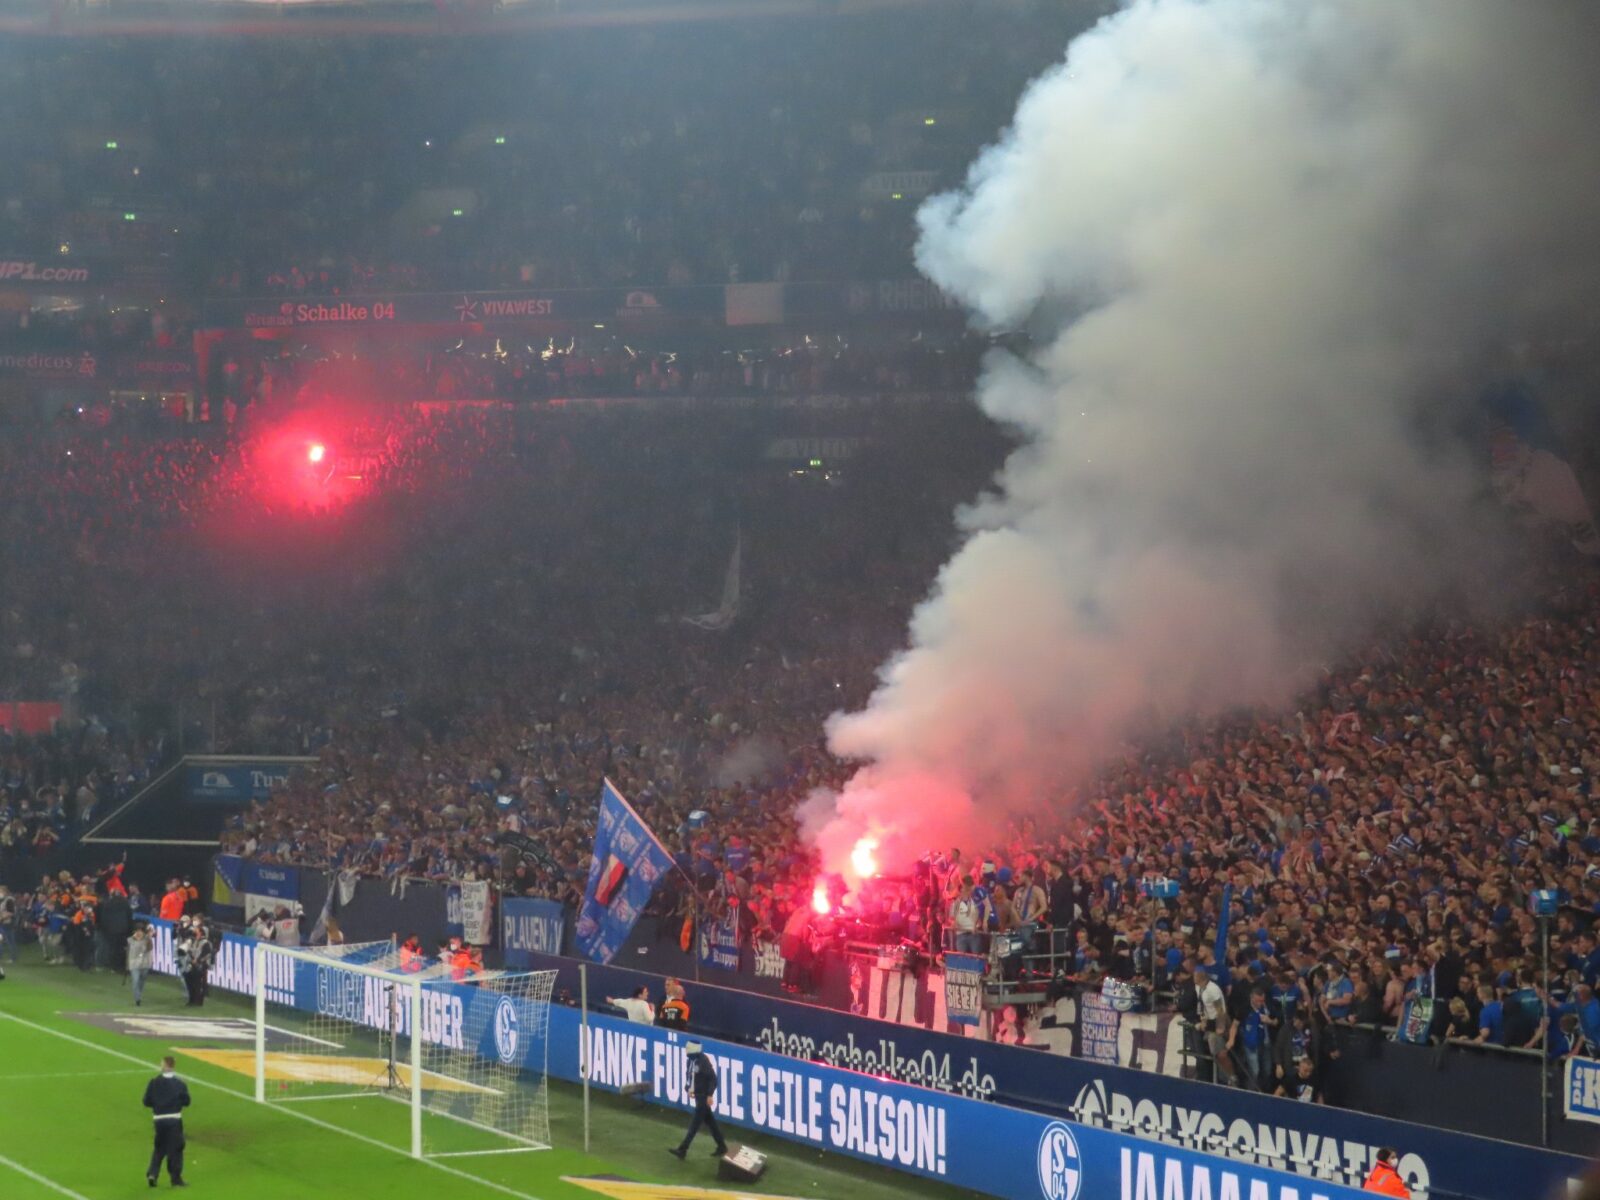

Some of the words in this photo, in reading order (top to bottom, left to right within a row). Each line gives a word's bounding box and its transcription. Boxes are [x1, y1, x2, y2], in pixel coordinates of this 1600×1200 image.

[296, 302, 368, 322] Schalke
[372, 302, 396, 320] 04
[483, 299, 553, 316] VIVAWEST
[579, 1024, 646, 1087] DANKE
[751, 1064, 822, 1142] GEILE
[831, 1083, 946, 1175] SAISON!
[1110, 1092, 1430, 1200] POLYGONVATO
